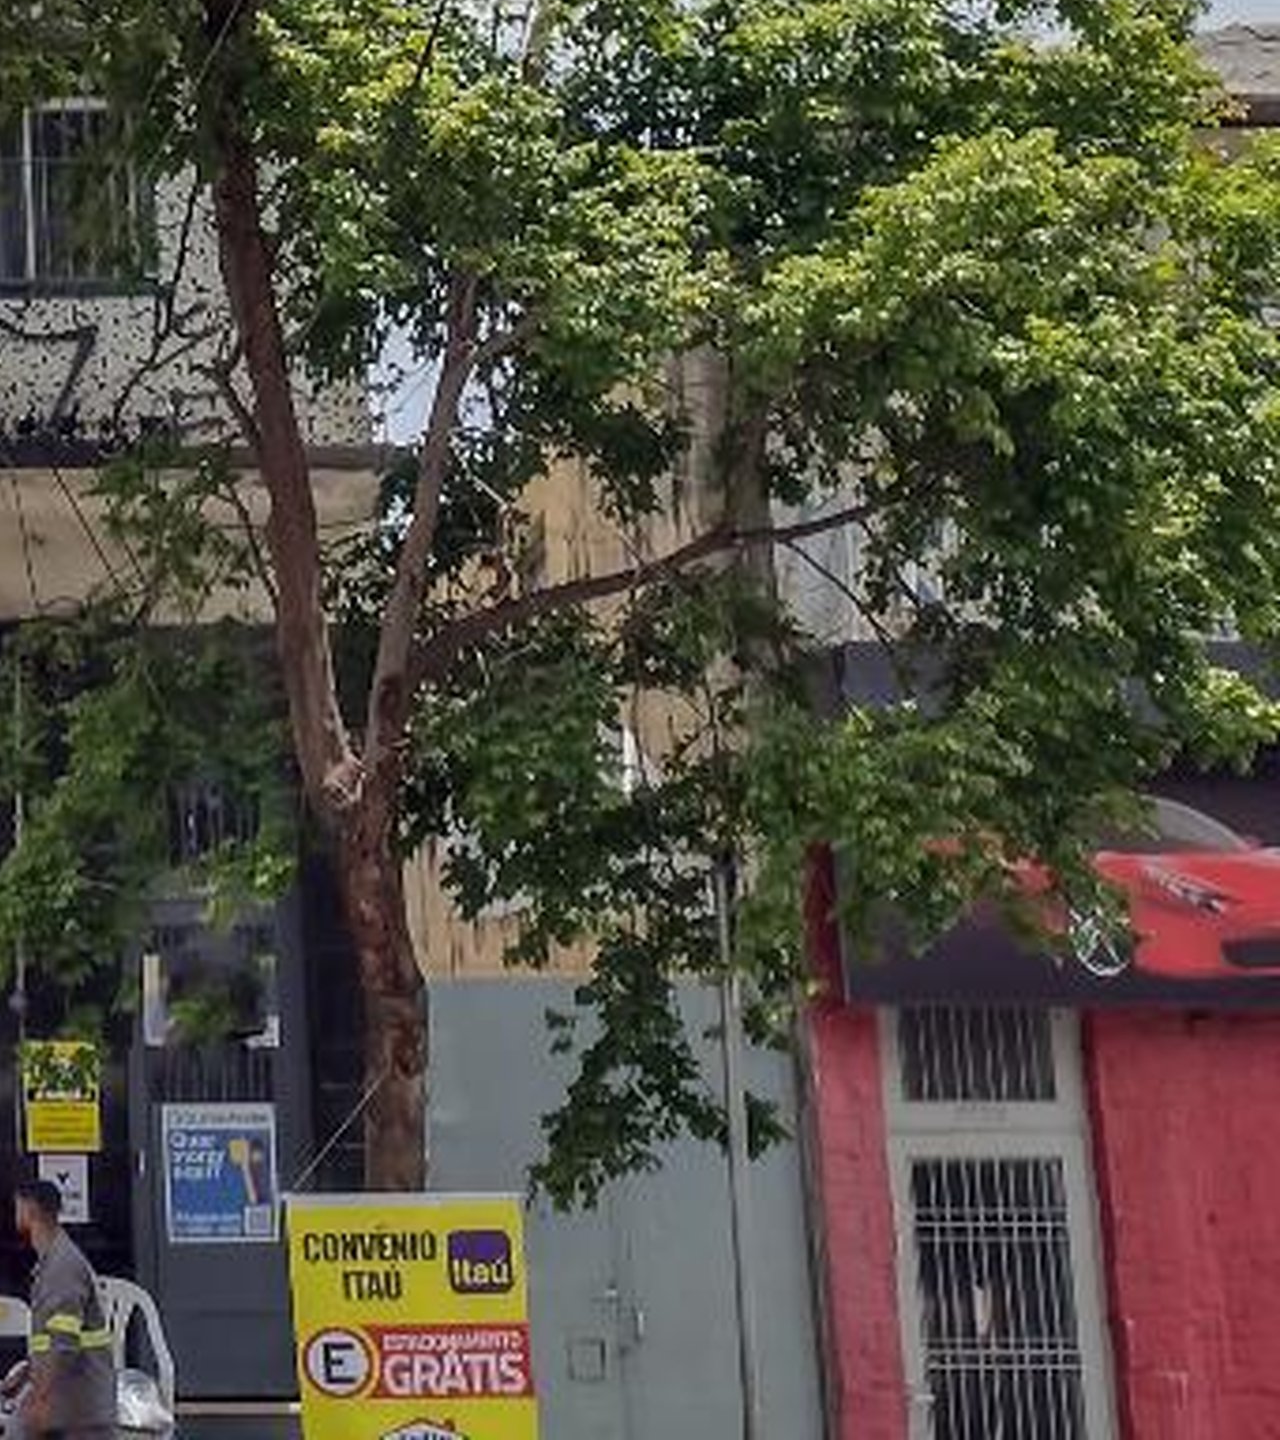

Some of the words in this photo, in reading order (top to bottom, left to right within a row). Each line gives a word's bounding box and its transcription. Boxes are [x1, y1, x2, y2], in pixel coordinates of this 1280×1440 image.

[304, 1224, 438, 1262] CONVÊNIO
[342, 1263, 403, 1300] ITAÚ
[323, 1342, 357, 1384] E
[383, 1346, 528, 1396] GRÁTIS
